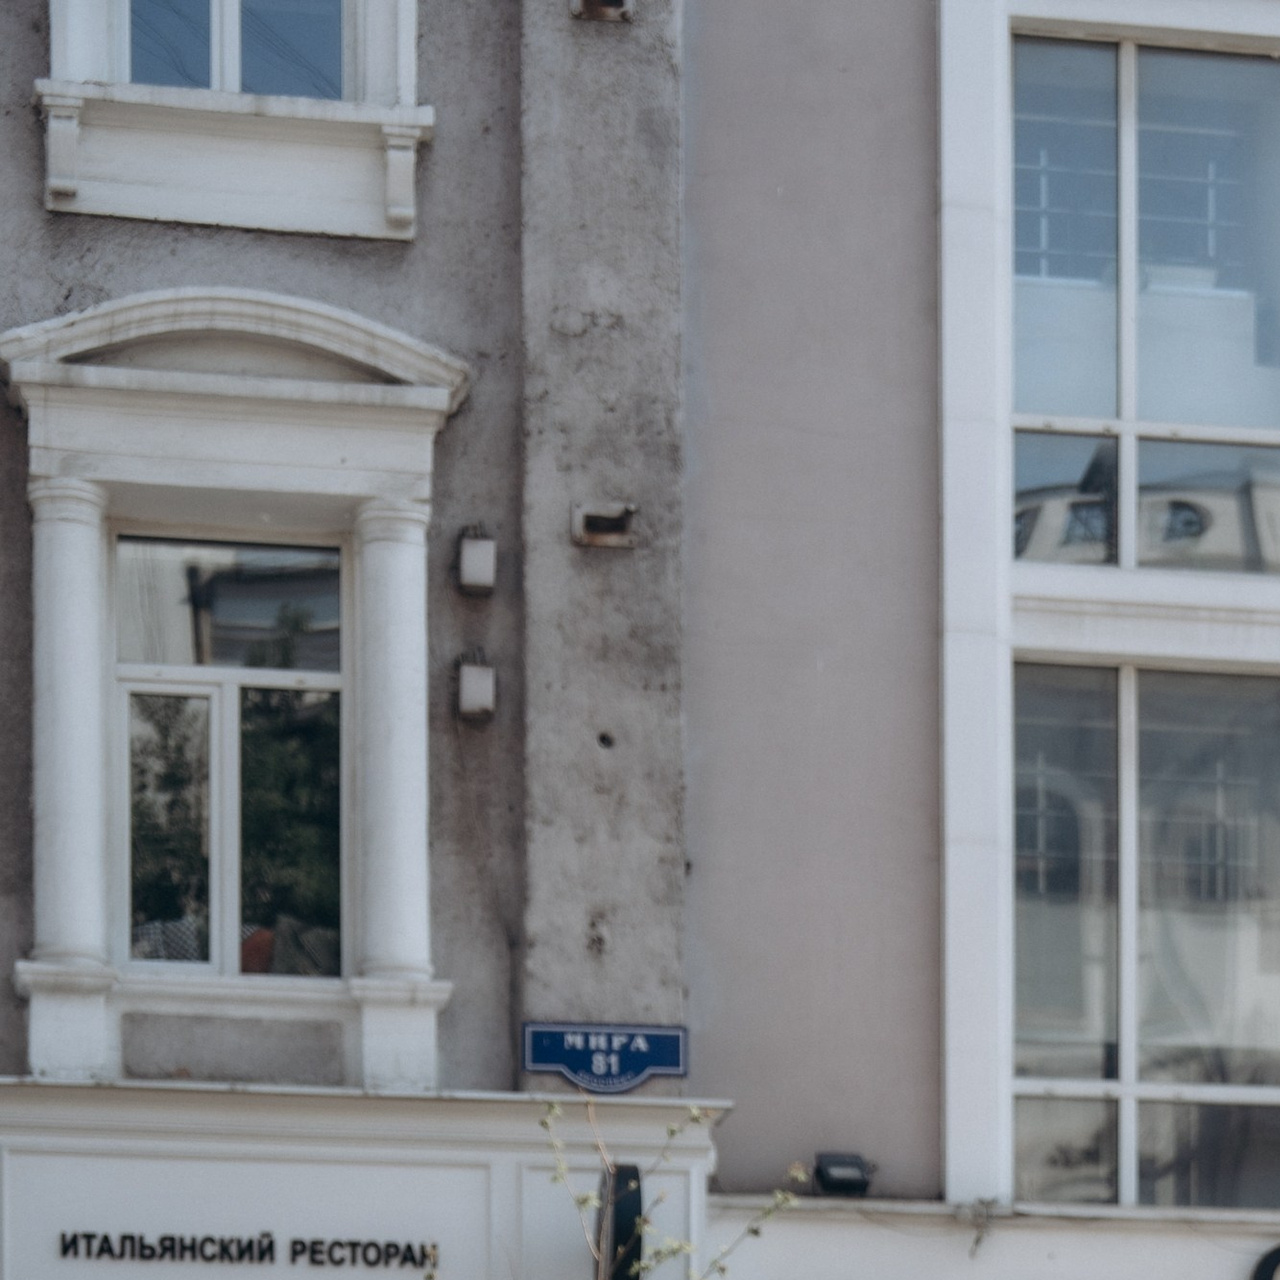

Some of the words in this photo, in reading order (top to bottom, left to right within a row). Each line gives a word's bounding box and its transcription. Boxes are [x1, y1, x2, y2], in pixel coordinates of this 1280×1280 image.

[564, 1033, 649, 1052] МИРА
[591, 1052, 620, 1075] 81
[60, 1231, 276, 1264] ИТАЛЬЯНСКИЙ
[289, 1240, 438, 1269] РЕСТОРАН
